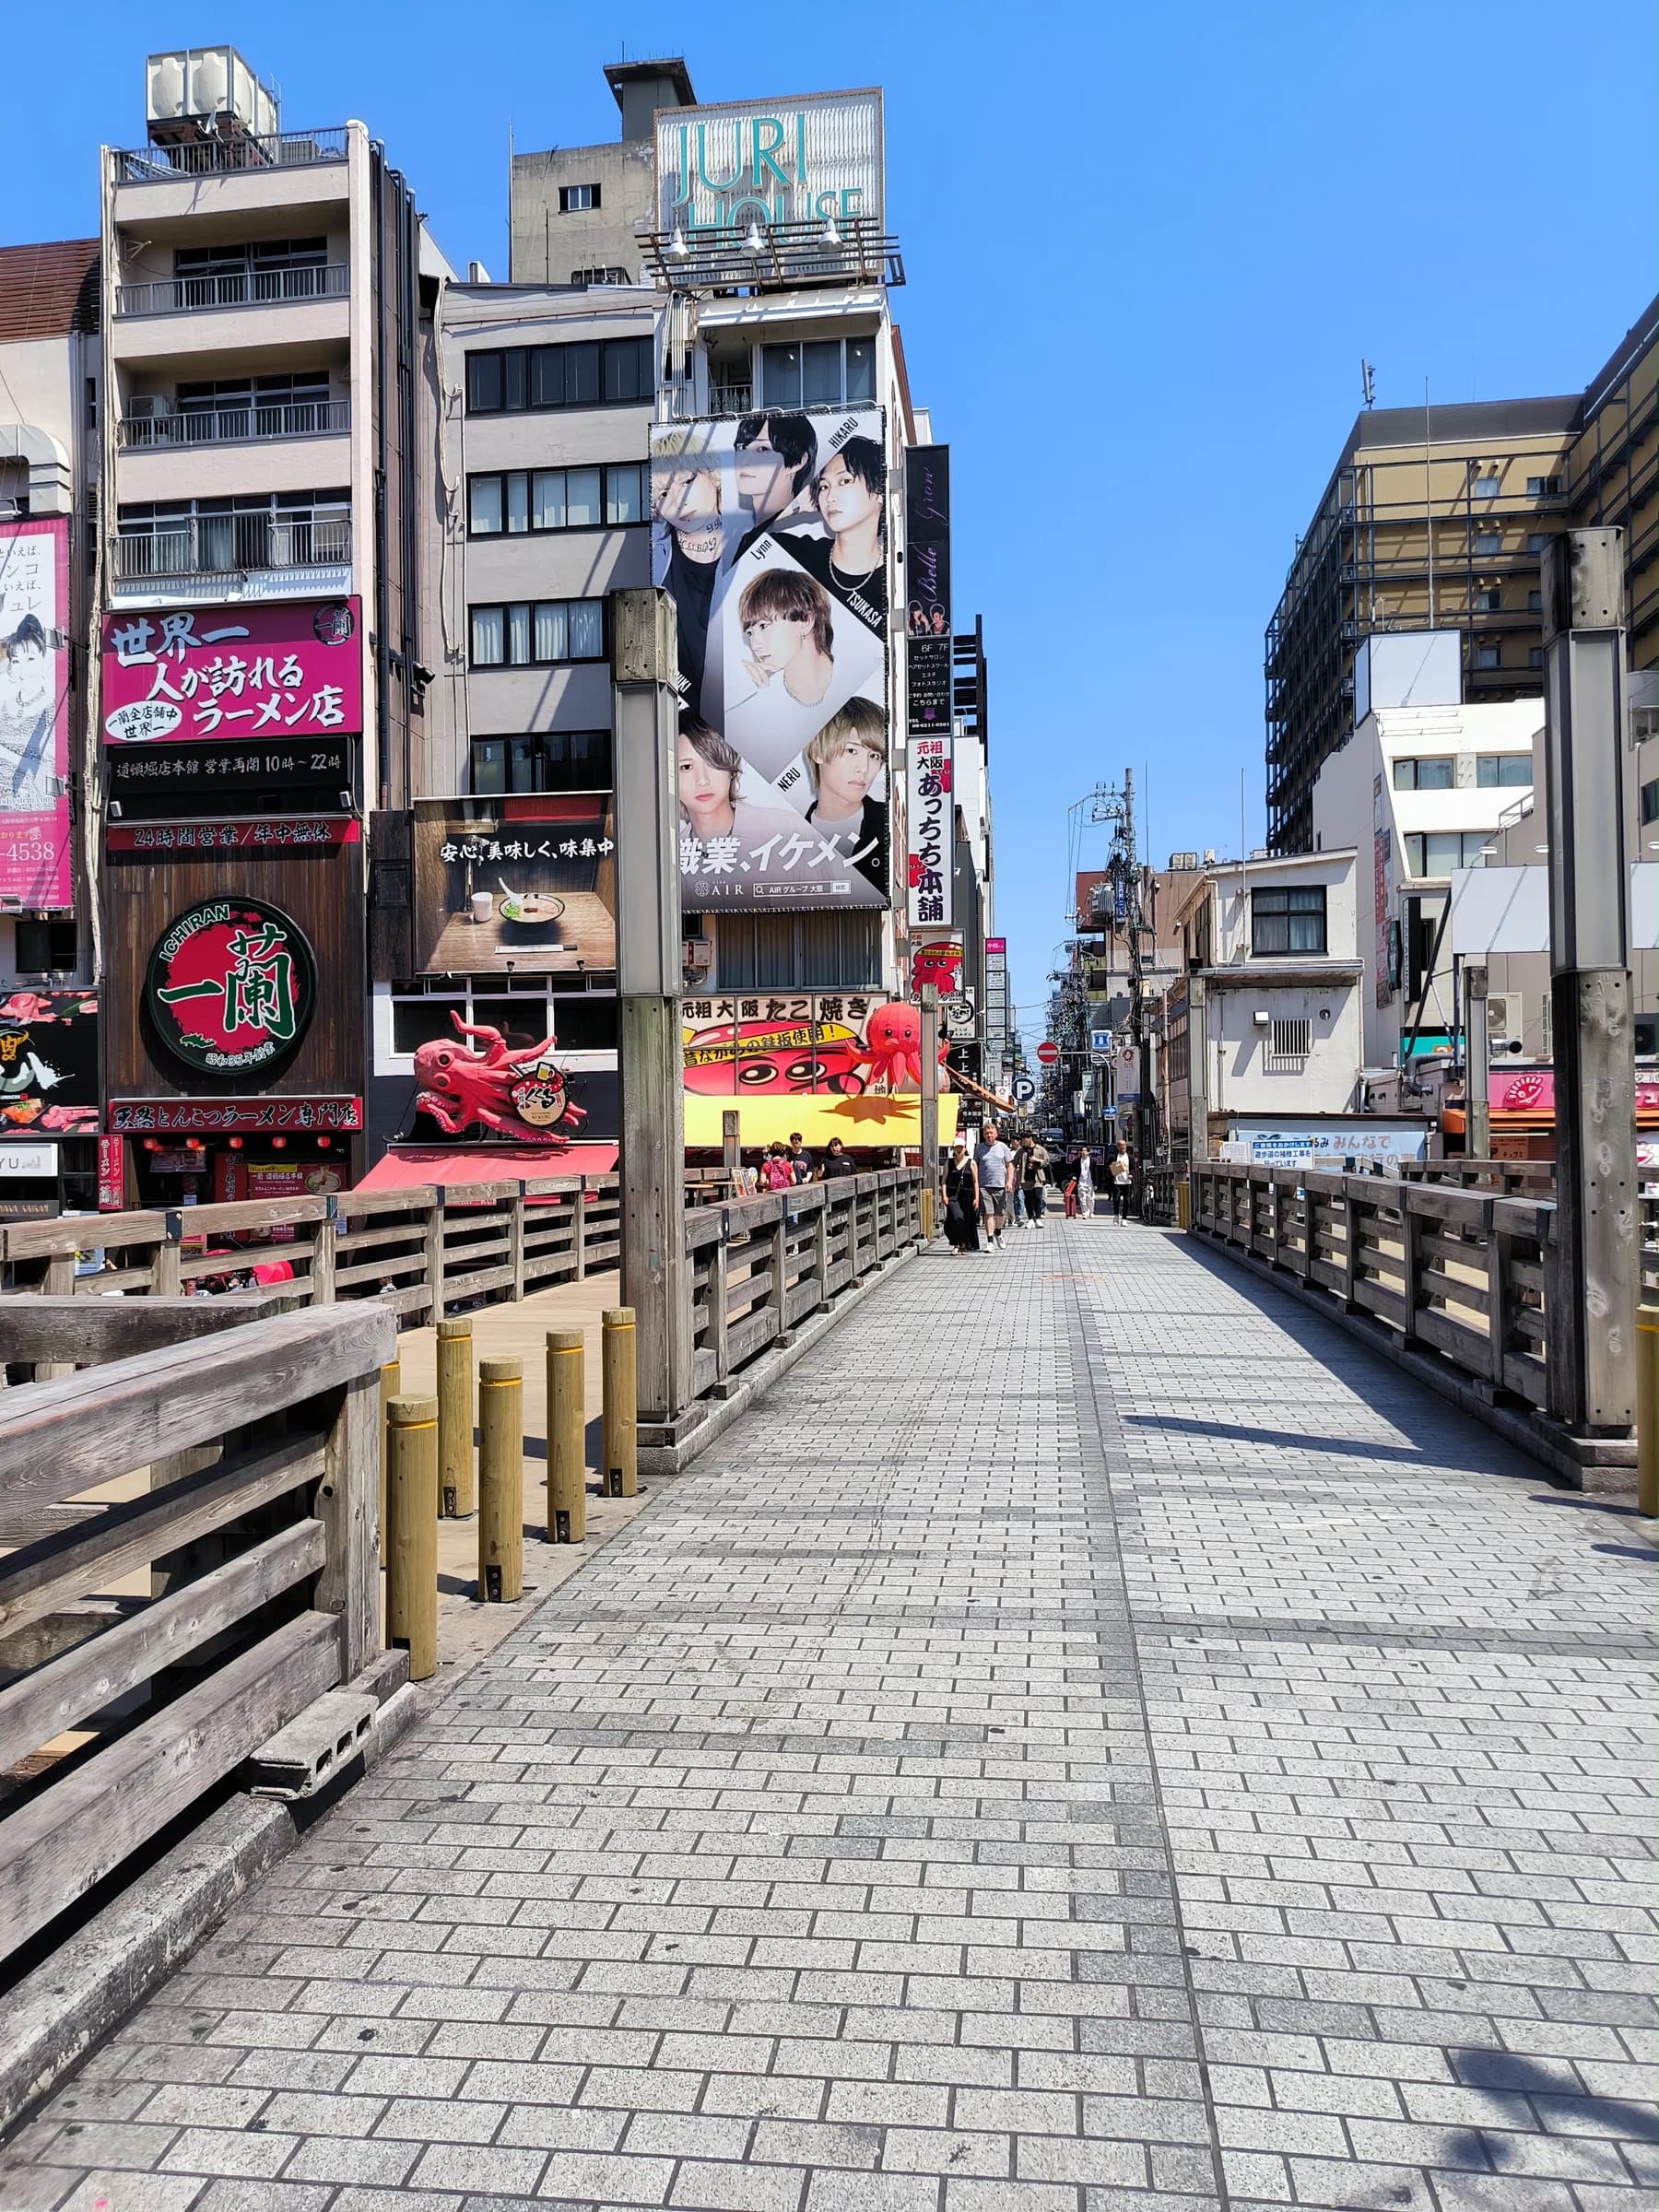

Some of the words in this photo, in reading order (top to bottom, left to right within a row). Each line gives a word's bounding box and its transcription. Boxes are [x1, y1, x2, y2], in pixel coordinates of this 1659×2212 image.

[671, 113, 807, 207] JURI
[688, 187, 863, 251] HOUSE
[829, 417, 859, 449] HIKARU
[751, 538, 773, 561] Lynn
[316, 607, 352, 638] 一蘭
[845, 590, 883, 629] TSUKASA
[111, 611, 250, 667] 世界一
[921, 644, 933, 653] 6F
[937, 643, 949, 652] 7F
[146, 653, 304, 702] 人が訪れる
[193, 684, 347, 735] ラーメン店
[912, 699, 946, 707] こちらまで
[124, 722, 165, 739] 世界一
[916, 740, 944, 756] 元祖
[916, 756, 944, 771] 大阪
[777, 767, 801, 793] NERU
[440, 836, 615, 865] 安心、美味しく、味集中
[917, 772, 945, 923] あっちち本舗
[712, 884, 745, 897] AIR
[783, 886, 808, 894] グループ
[159, 903, 230, 963] ICHIRAN
[157, 922, 296, 1040] 一蘭
[681, 997, 869, 1022] 元祖大阪たこ焼き
[1017, 1081, 1033, 1102] P
[112, 1100, 359, 1130] 天然とんこつラーメン専門店
